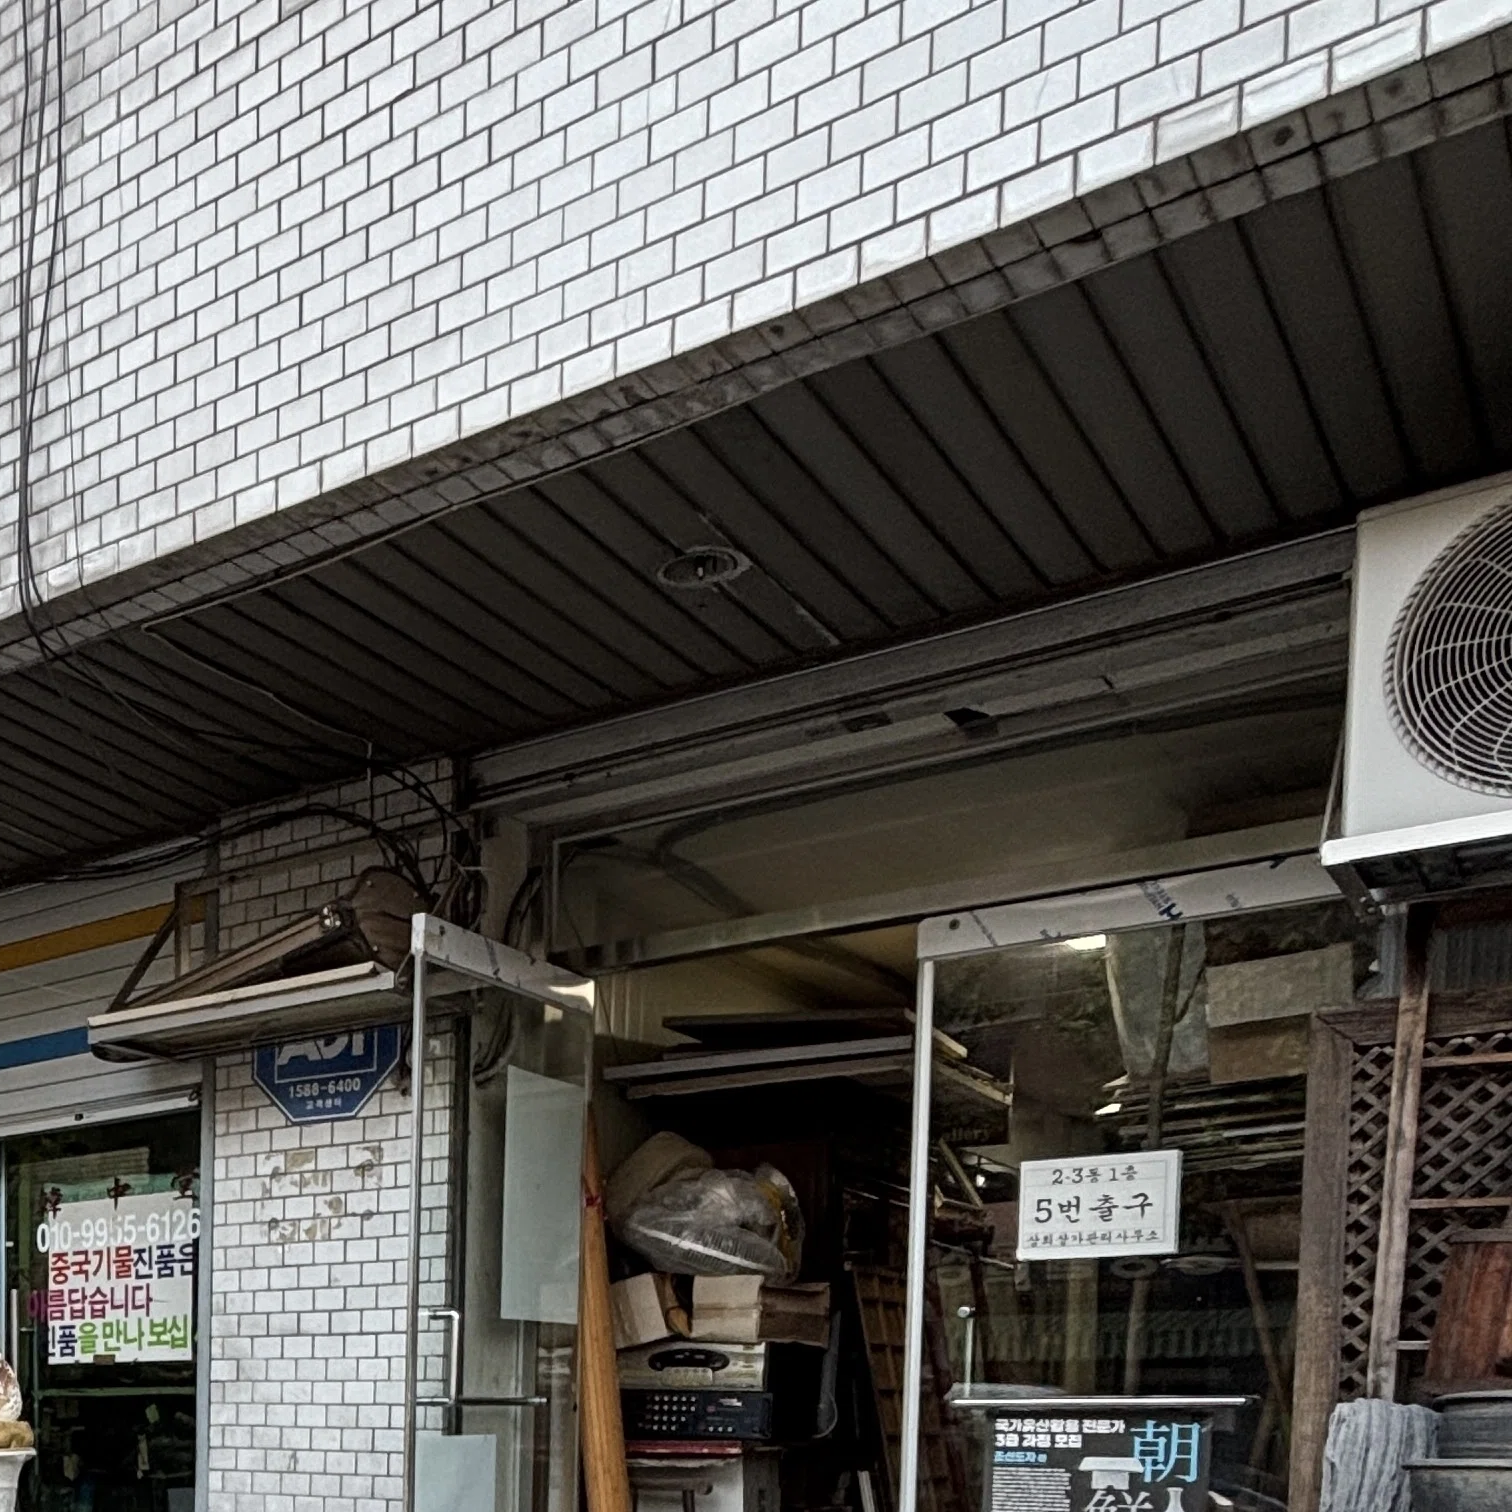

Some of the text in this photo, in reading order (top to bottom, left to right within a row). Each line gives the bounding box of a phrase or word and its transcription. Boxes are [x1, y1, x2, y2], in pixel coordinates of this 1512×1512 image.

[289, 1078, 361, 1099] 1588-6400
[305, 1097, 343, 1110] 고객센터
[1034, 1192, 1154, 1223] 5번 출구
[27, 1283, 153, 1323] 아름답습니다
[147, 1314, 200, 1349] 보십
